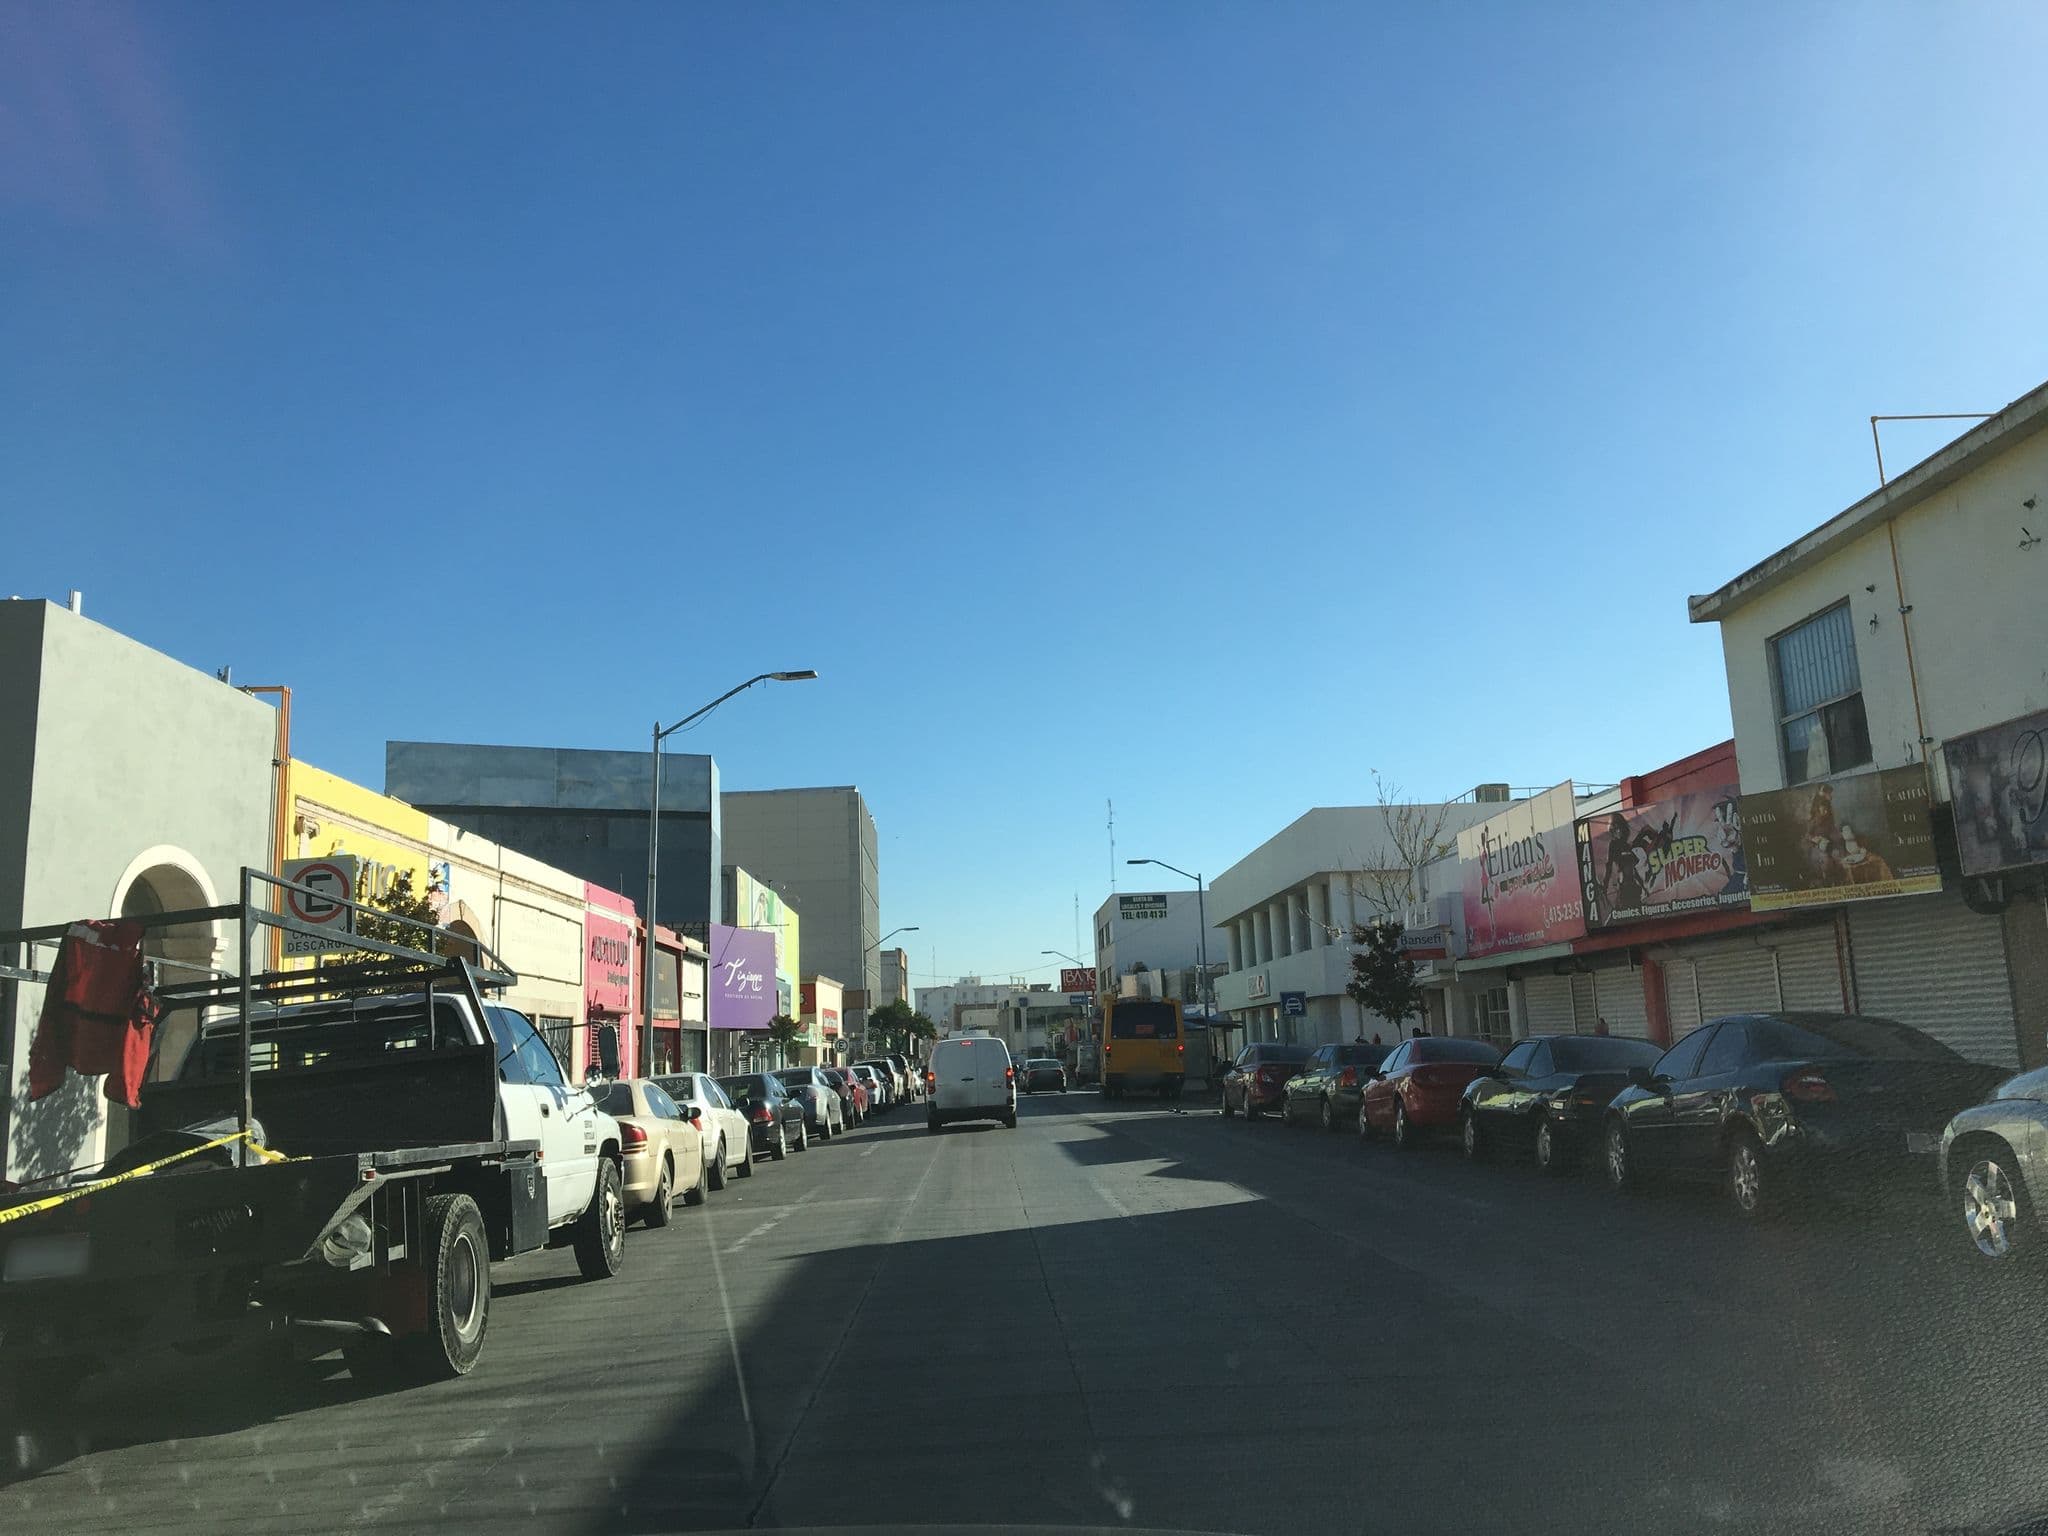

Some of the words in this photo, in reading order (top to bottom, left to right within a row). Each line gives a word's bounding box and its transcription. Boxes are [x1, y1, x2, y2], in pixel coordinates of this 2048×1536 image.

[1577, 822, 1599, 921] MANGA
[1664, 852, 1721, 890] MONERO
[305, 874, 333, 913] E
[287, 939, 346, 953] DESCARG
[1400, 933, 1441, 946] Bansefi
